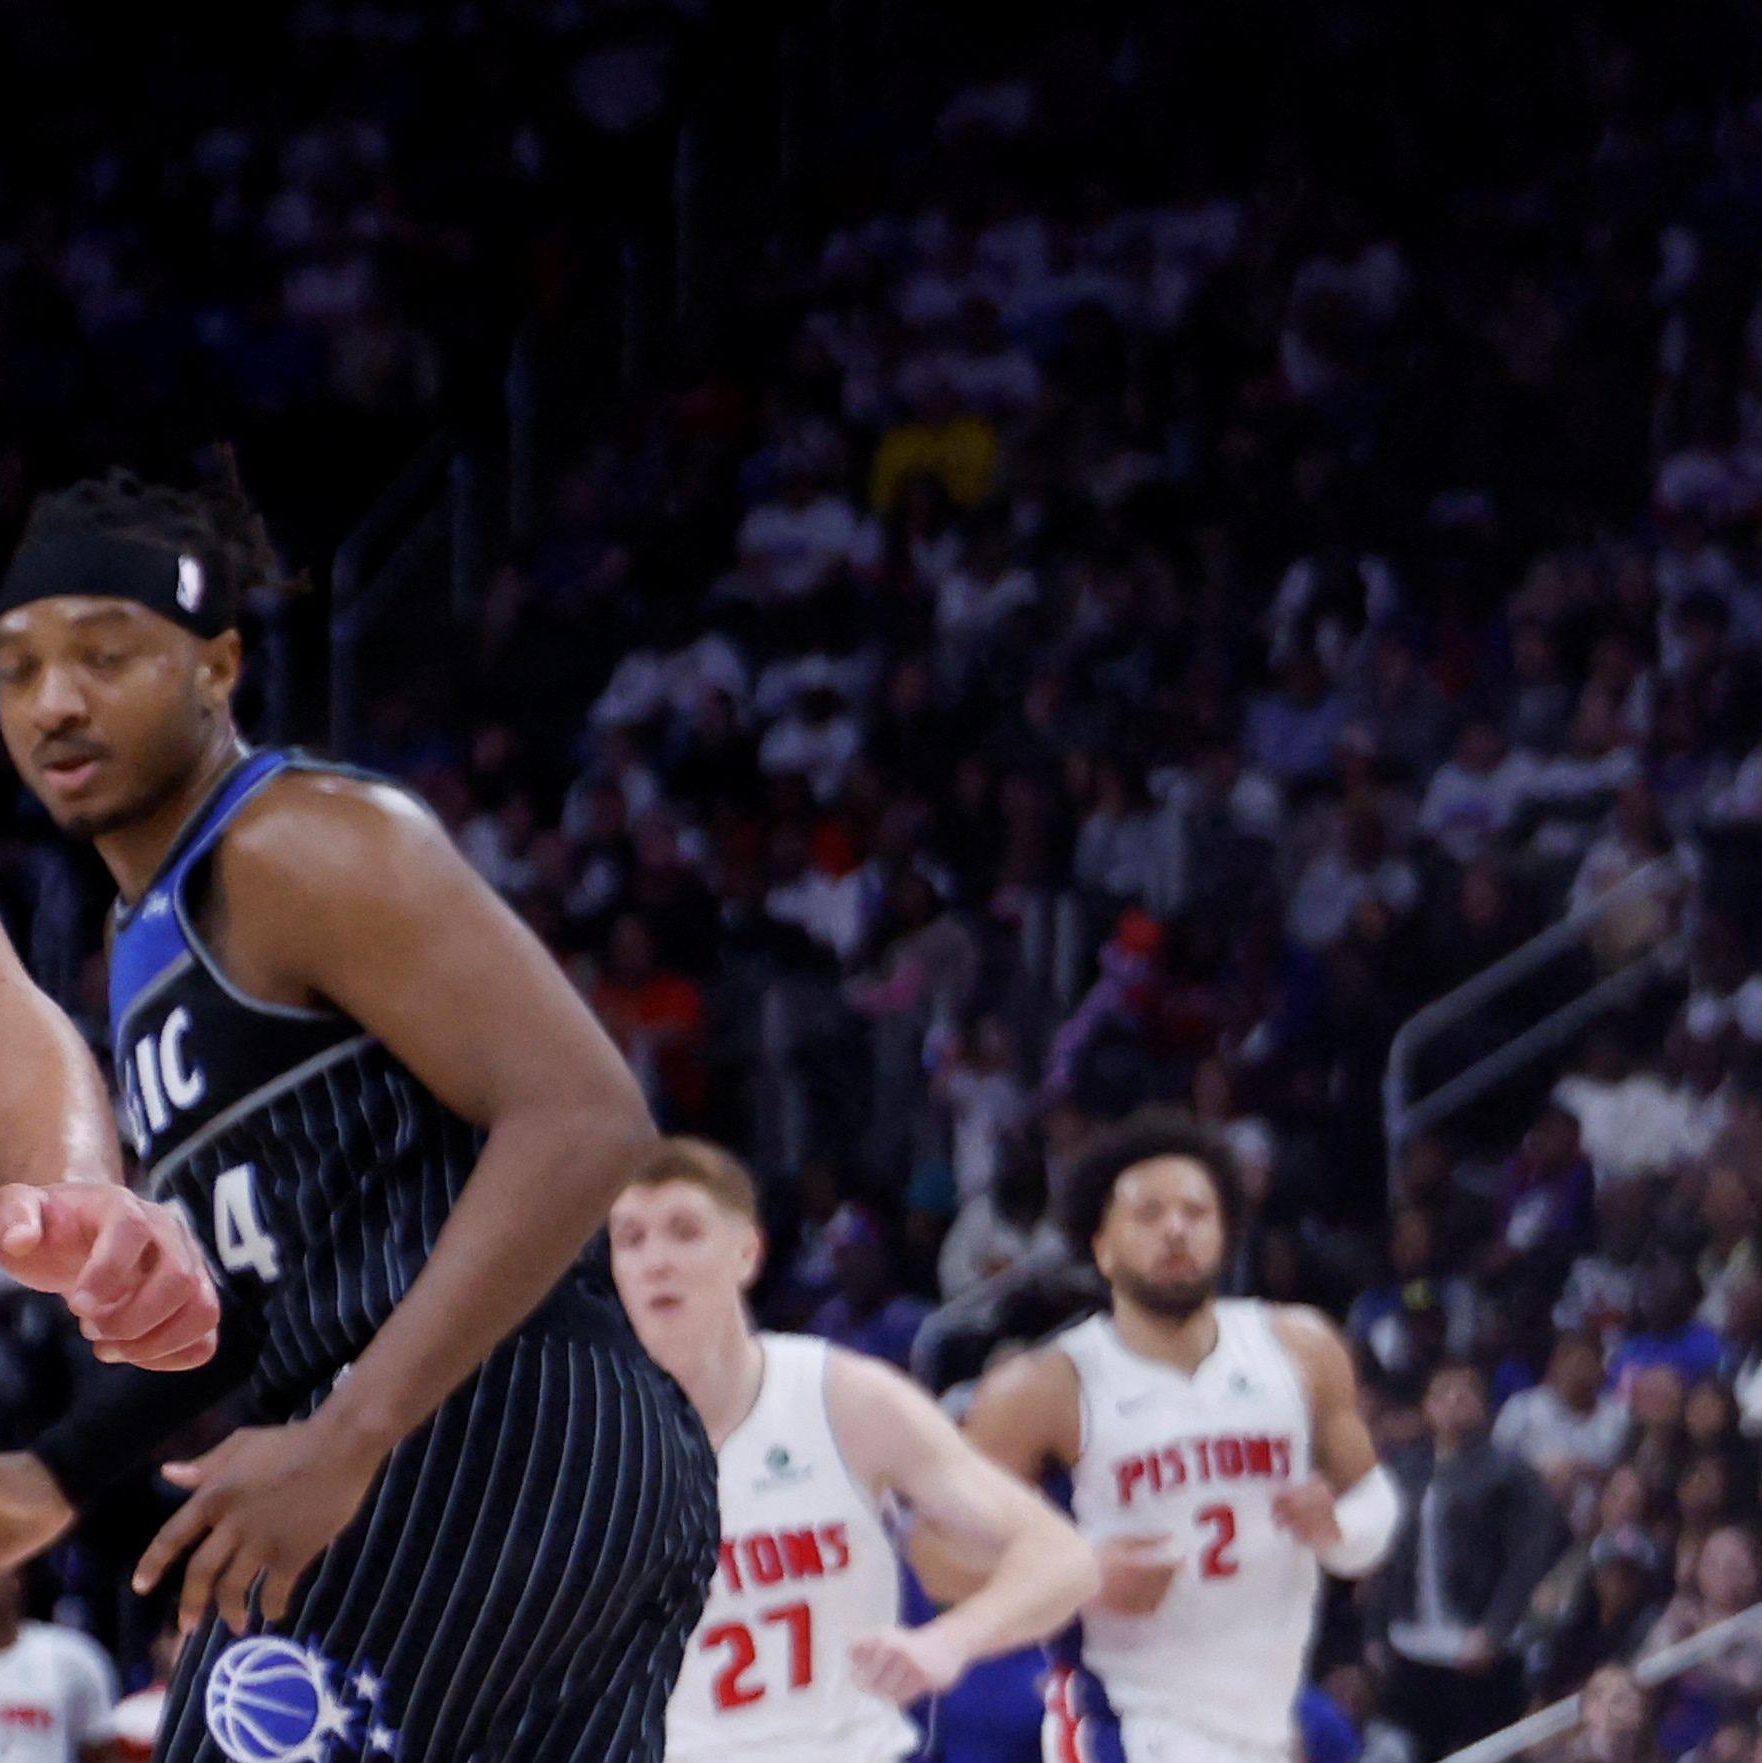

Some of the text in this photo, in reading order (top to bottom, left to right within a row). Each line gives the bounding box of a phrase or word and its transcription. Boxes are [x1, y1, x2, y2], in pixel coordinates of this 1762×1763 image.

[1113, 1428, 1293, 1507] PISTONS
[1194, 1502, 1240, 1580] 2
[700, 1599, 814, 1713] 27
